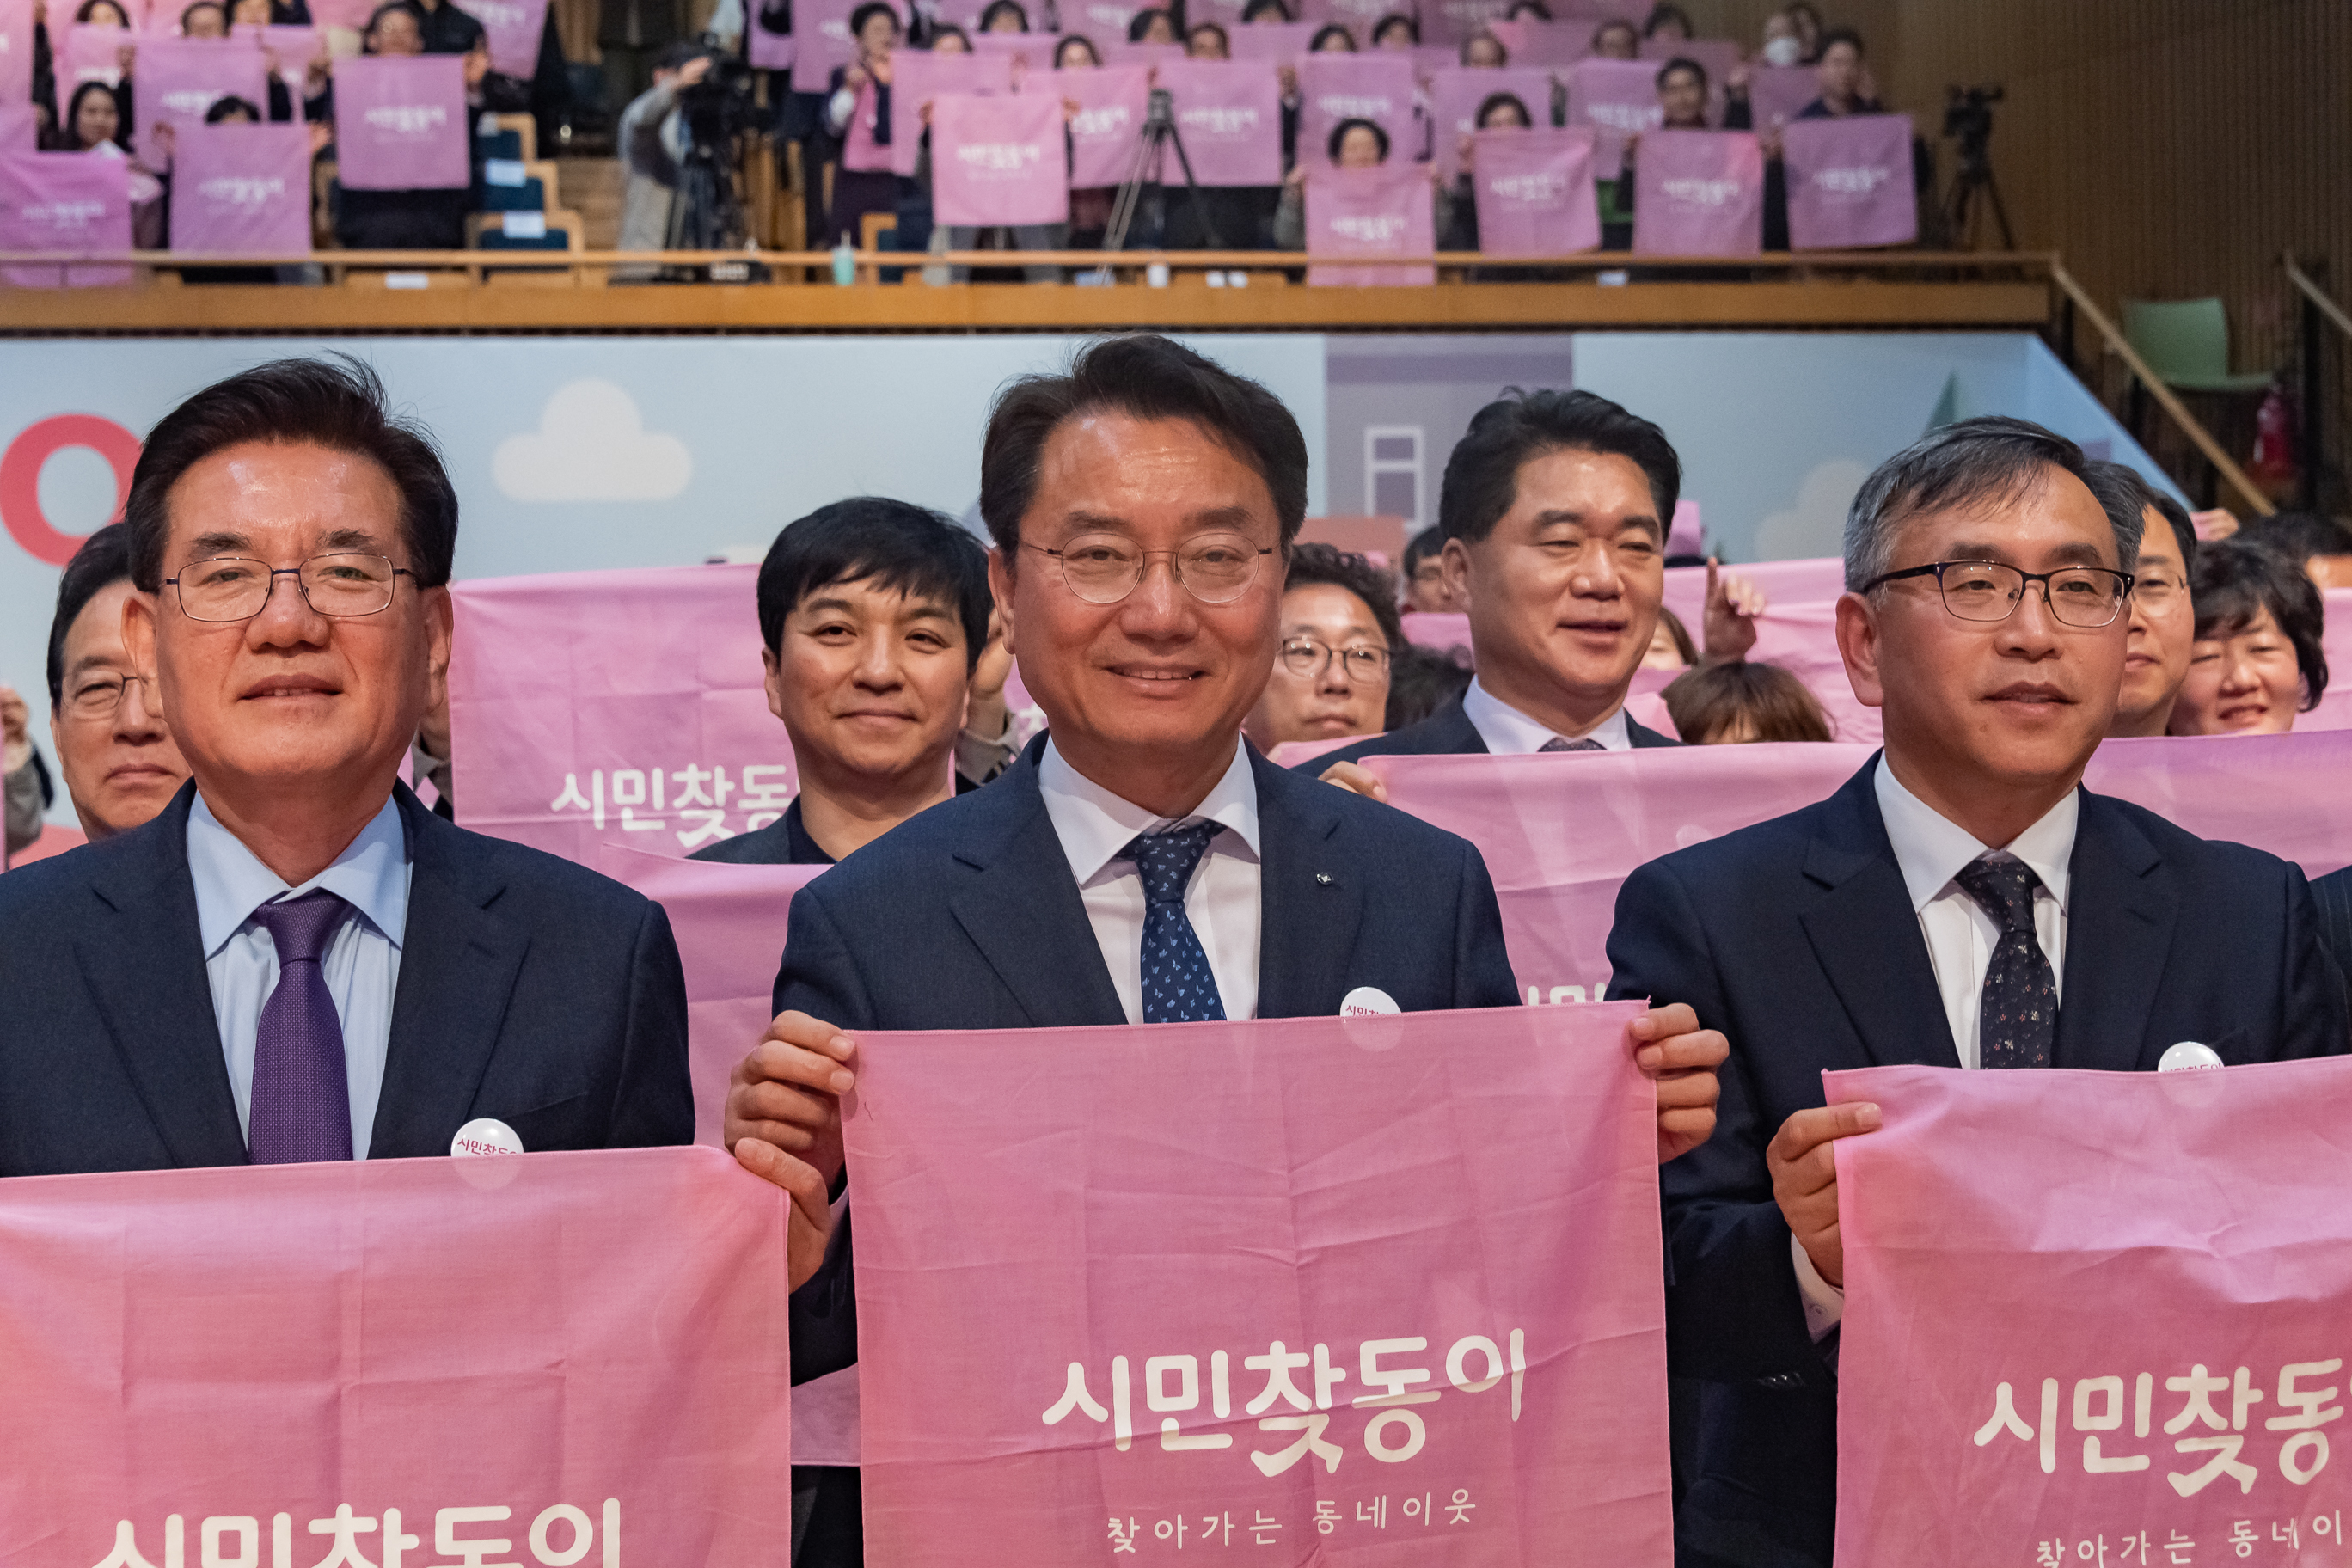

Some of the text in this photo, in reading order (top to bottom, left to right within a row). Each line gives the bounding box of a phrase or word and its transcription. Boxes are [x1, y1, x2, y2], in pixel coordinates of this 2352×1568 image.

[551, 763, 800, 848] 시민찾동
[1042, 1328, 1527, 1477] 시민찾동이
[1973, 1358, 2352, 1498] 시민찾동
[1107, 1488, 1475, 1553] 찾아가는 동네이웃
[2037, 1530, 2196, 1568] 찾아가는
